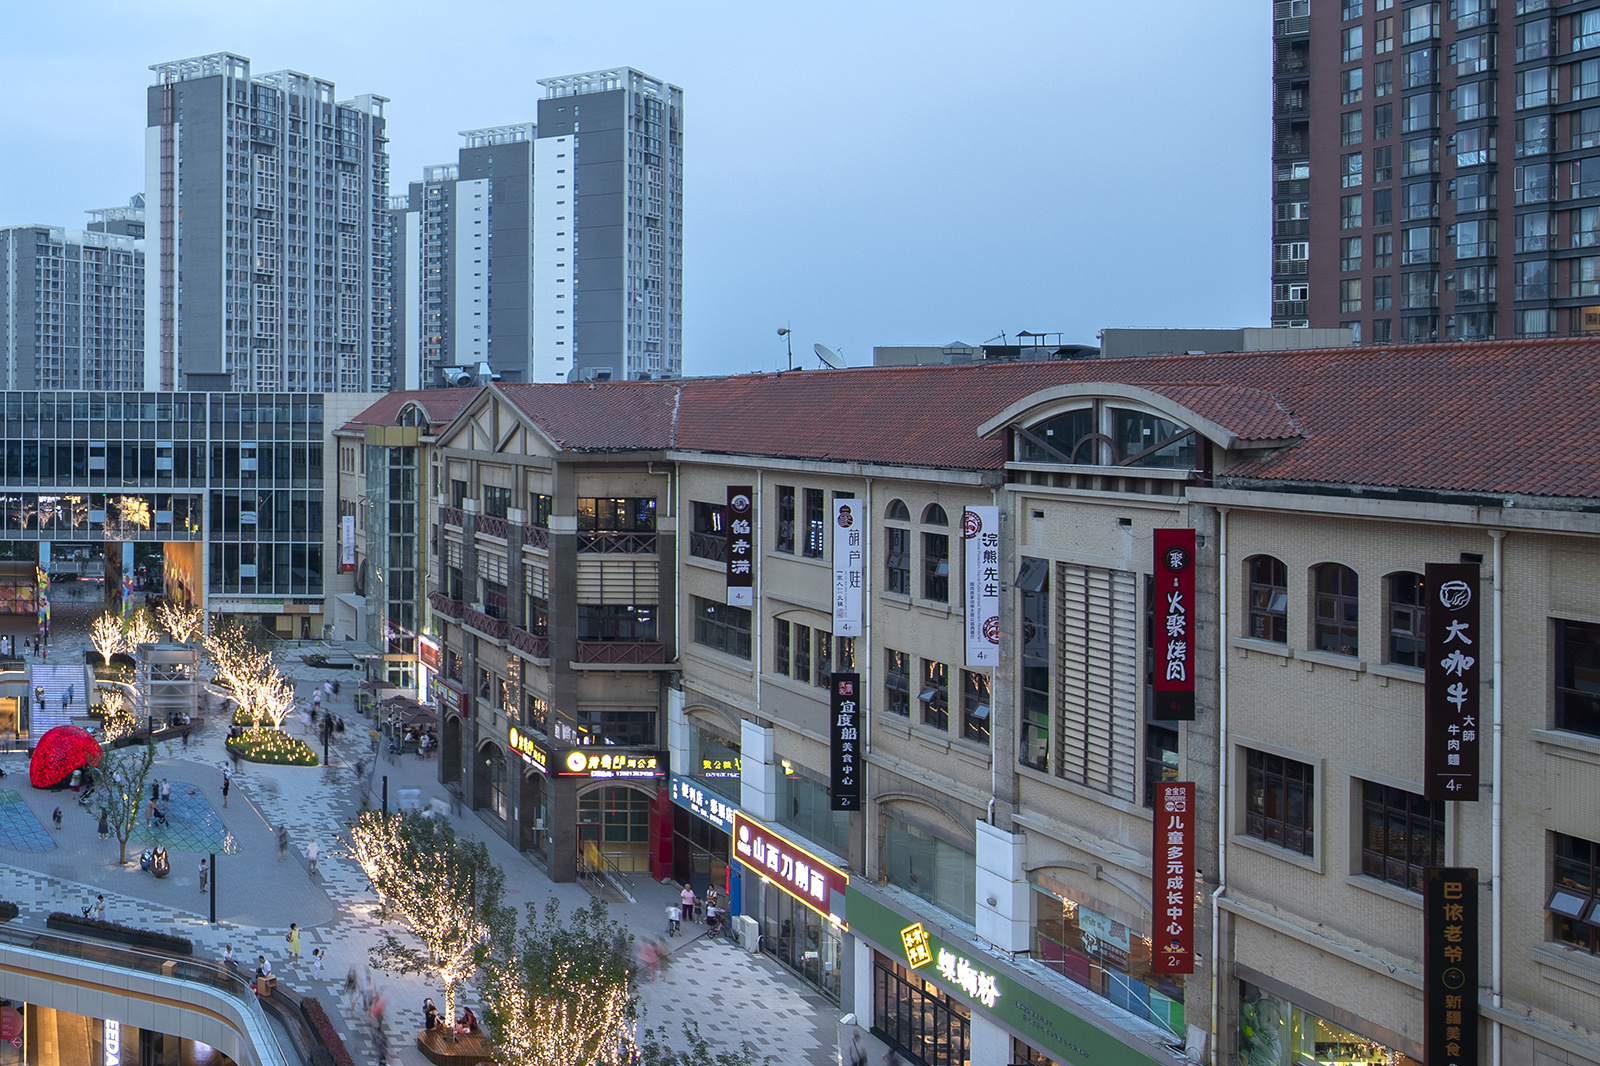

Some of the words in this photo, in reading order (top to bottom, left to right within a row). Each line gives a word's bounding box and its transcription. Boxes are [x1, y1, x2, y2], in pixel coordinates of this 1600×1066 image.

[848, 529, 861, 589] 葫芦娃
[982, 532, 998, 598] 浣熊先生
[1170, 552, 1184, 568] 聚
[1166, 590, 1187, 682] 火聚烤肉
[1440, 619, 1475, 713] 大咖牛
[1462, 715, 1475, 742] 大師
[1445, 779, 1462, 792] 4F
[753, 836, 826, 902] 山西刀削面
[1166, 816, 1185, 936] 儿童多元成长中心
[1443, 882, 1464, 963] 巴依老爷
[1168, 956, 1181, 967] 2F
[1445, 994, 1462, 1057] 新疆美食
